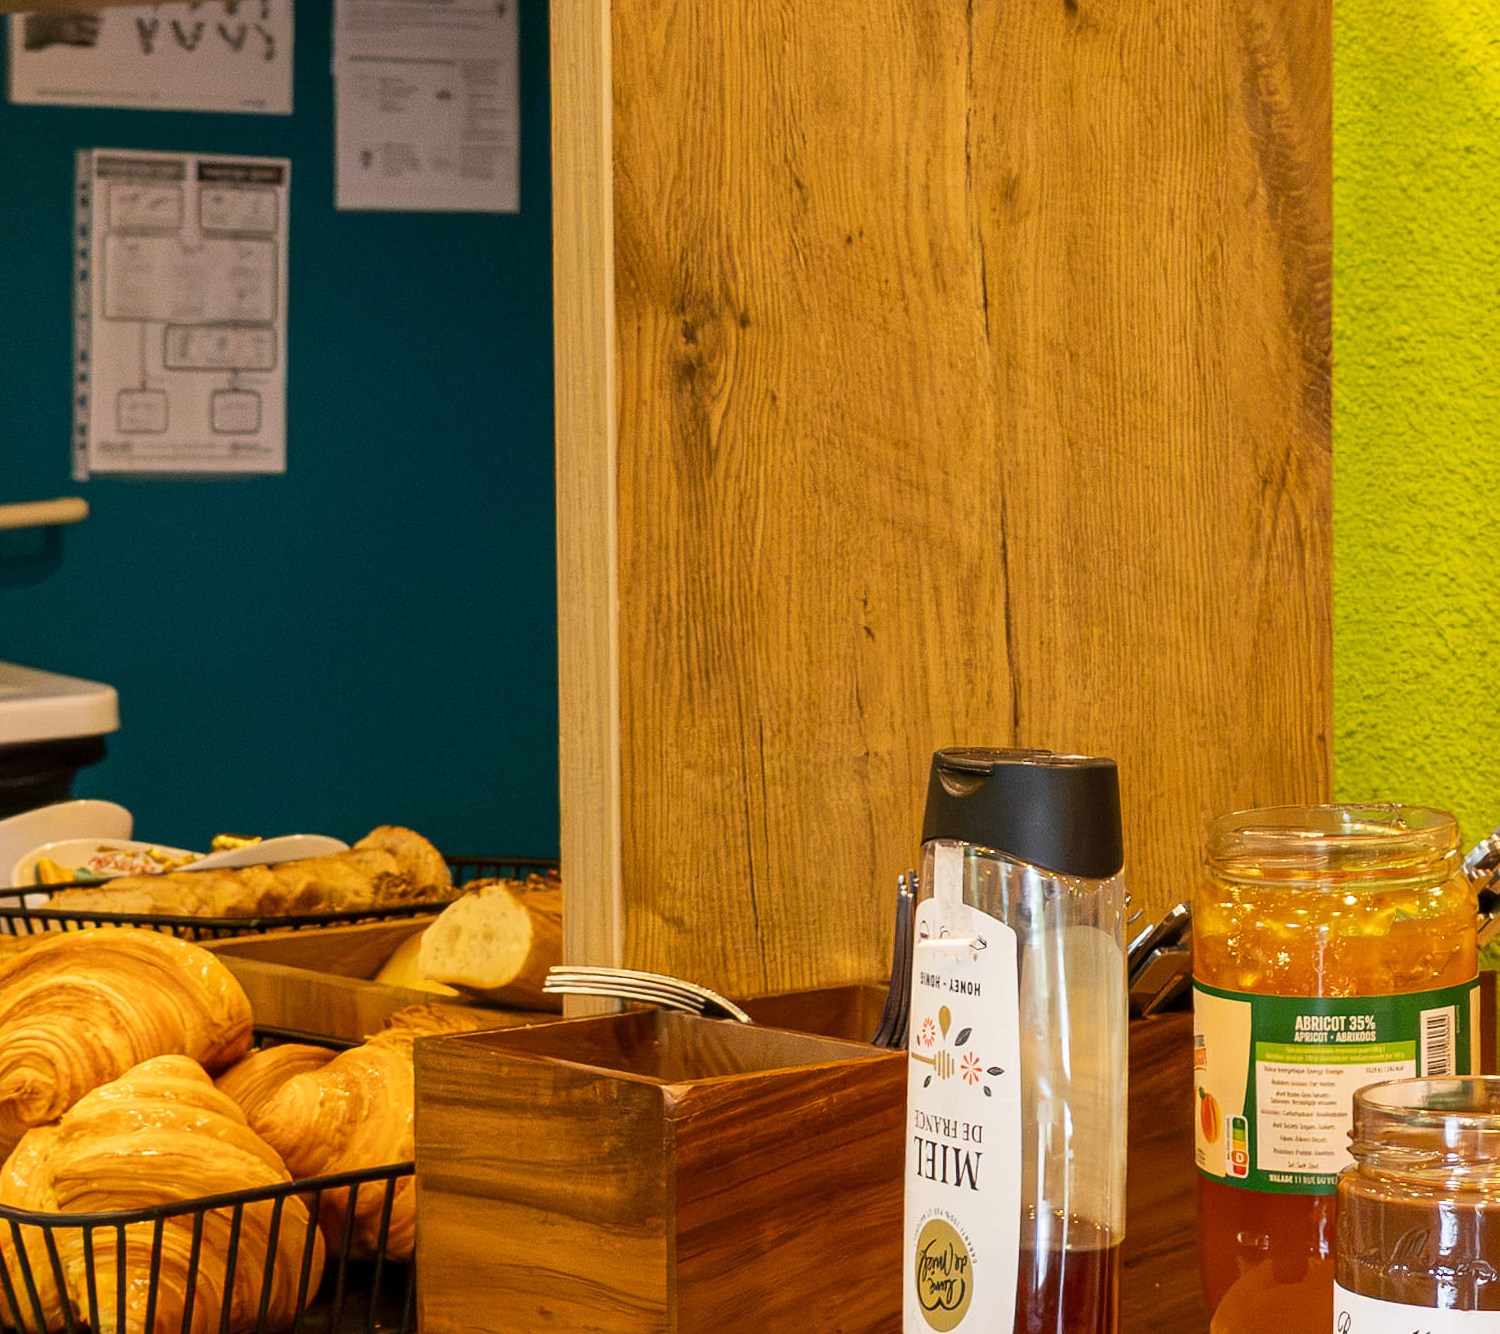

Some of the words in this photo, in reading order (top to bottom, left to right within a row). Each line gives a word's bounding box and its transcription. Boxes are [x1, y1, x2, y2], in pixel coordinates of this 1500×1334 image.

[948, 978, 981, 997] HONEY
[1294, 1015, 1347, 1031] ABRICOT
[1349, 1014, 1376, 1031] 35%
[1294, 1031, 1329, 1043] APRICOT
[915, 1109, 958, 1139] FRANCE
[963, 1122, 984, 1144] DE
[914, 1136, 983, 1191] MIEL
